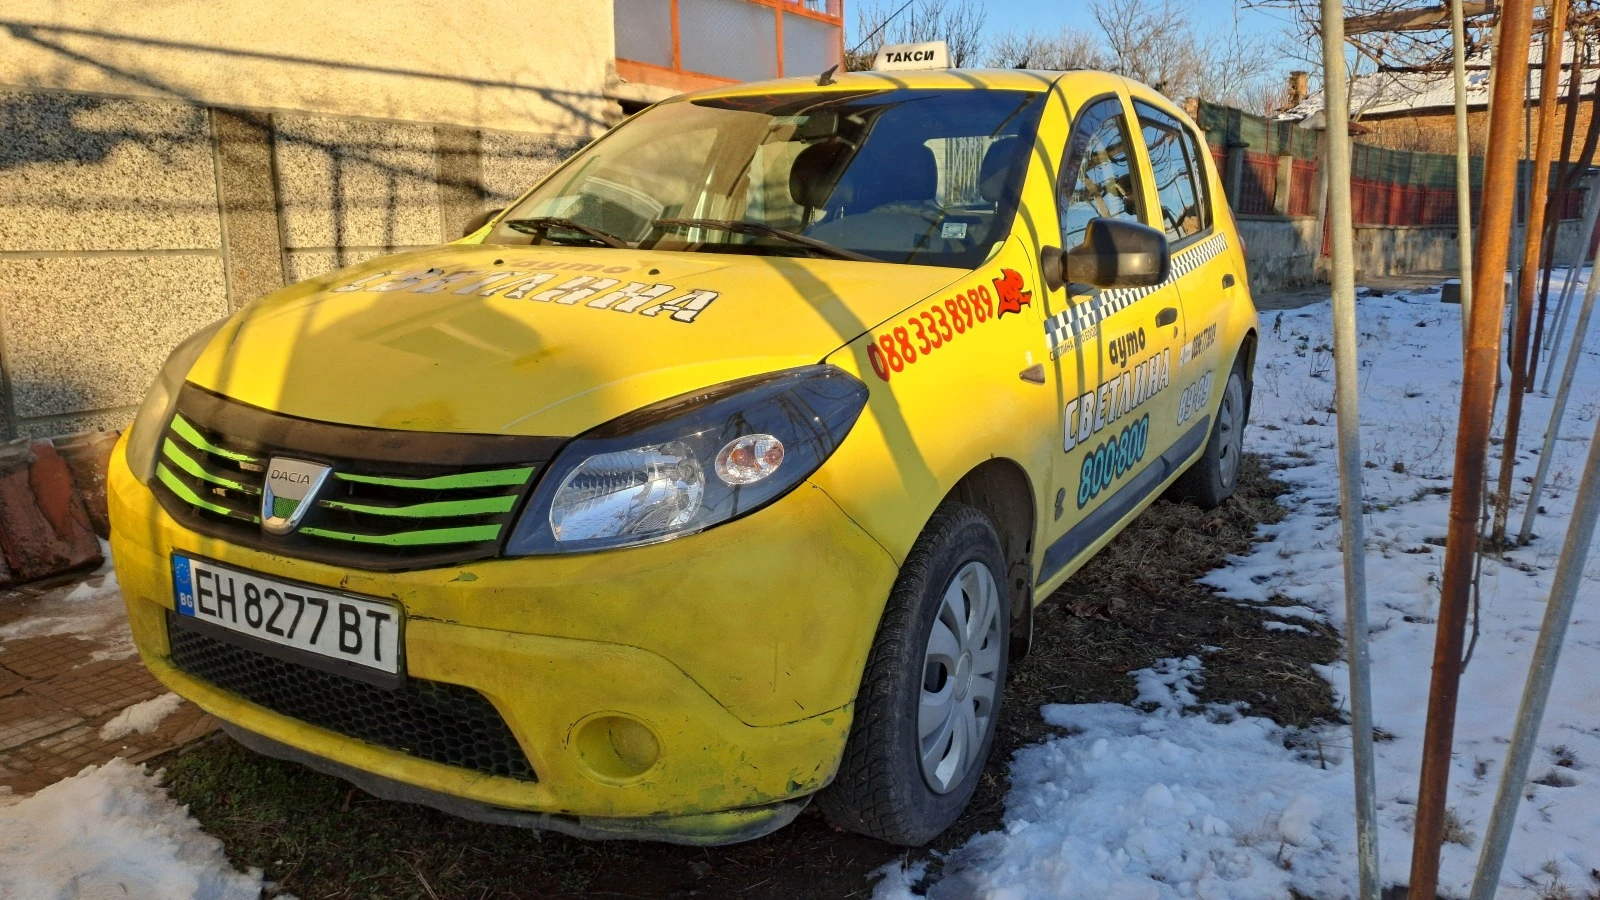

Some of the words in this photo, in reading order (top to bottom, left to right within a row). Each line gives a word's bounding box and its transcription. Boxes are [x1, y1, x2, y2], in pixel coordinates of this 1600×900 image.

[885, 50, 935, 63] ТАКСИ
[1064, 347, 1170, 454] СВЕТЛИНА
[270, 469, 311, 486] DACIA
[180, 591, 194, 609] BG
[194, 567, 238, 624] EH
[243, 582, 329, 646] 8277
[338, 602, 391, 662] BT
